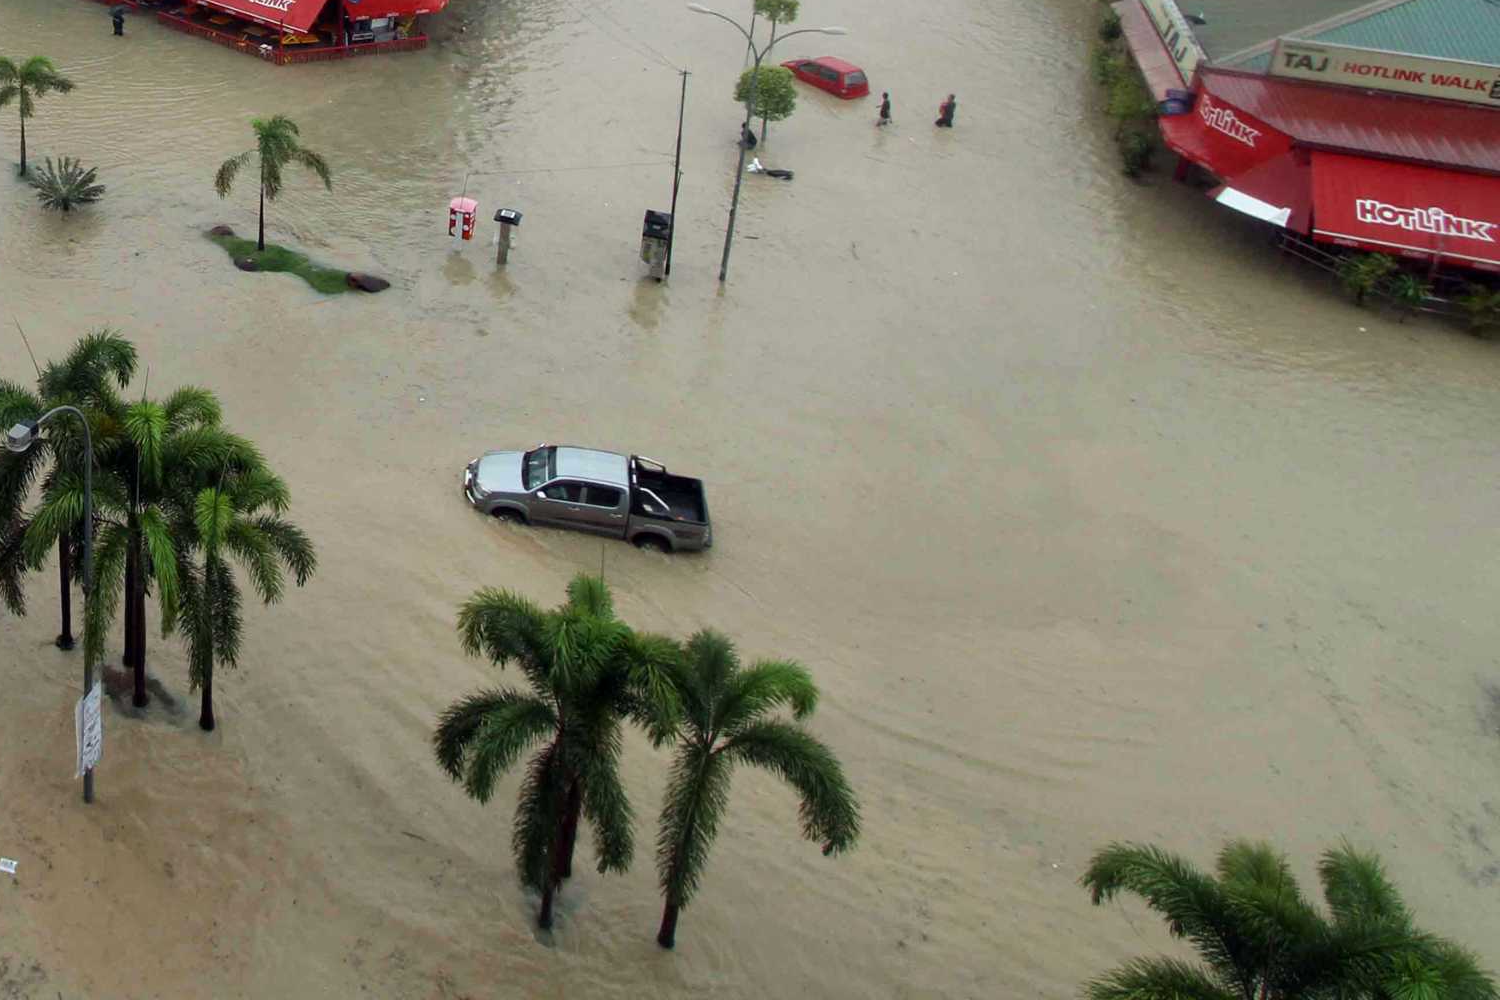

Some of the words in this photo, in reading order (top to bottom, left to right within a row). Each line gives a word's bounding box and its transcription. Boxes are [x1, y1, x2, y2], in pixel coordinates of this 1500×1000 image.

[1284, 53, 1329, 72] TAJ
[1343, 61, 1426, 83] HOTLINK
[1431, 73, 1489, 92] WALK
